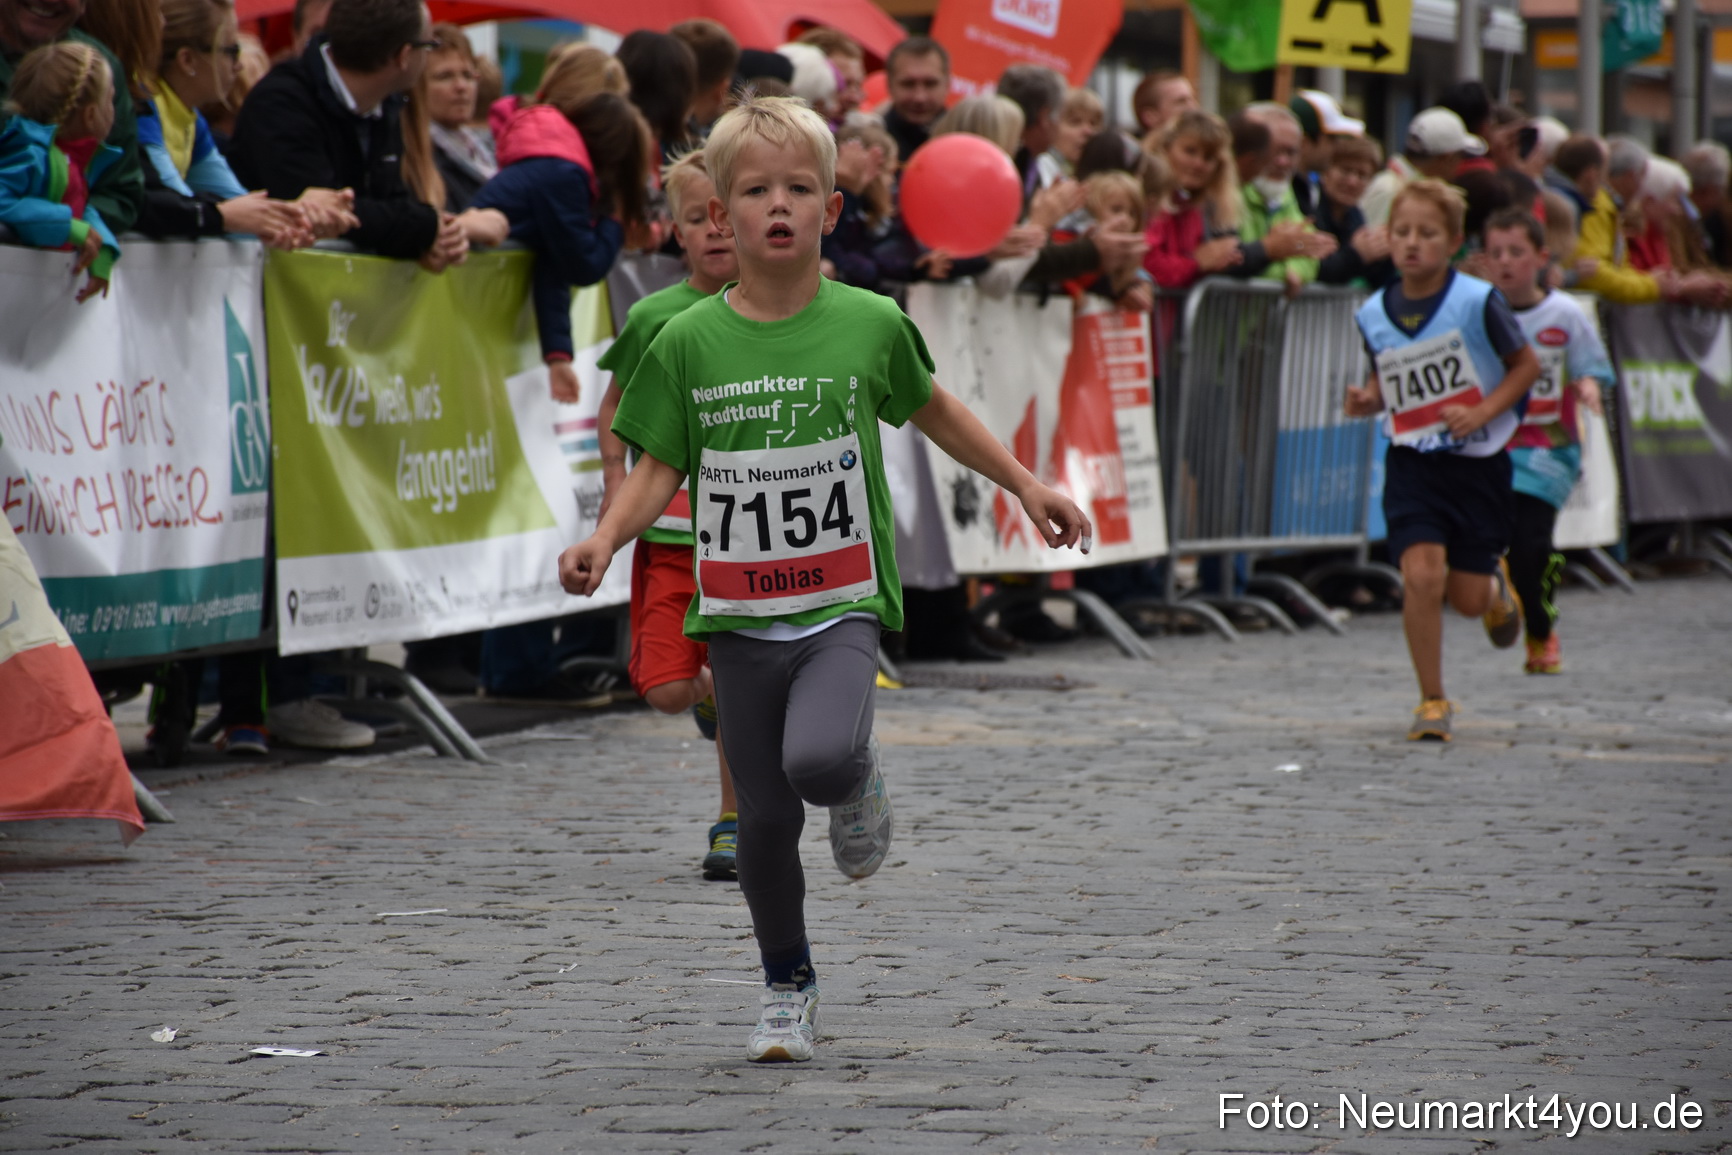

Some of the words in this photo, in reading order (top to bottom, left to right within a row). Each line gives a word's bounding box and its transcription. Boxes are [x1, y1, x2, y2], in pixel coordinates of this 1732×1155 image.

[692, 375, 808, 405] Neumarkter
[1386, 356, 1468, 407] 7402
[698, 399, 783, 429] Stadtlauf
[396, 429, 496, 514] langgeht!
[700, 465, 744, 484] PARTL
[747, 459, 834, 483] Neumarkt
[708, 479, 854, 552] 7154
[855, 530, 862, 541] K
[703, 547, 710, 558] 4
[743, 566, 824, 594] Tobias
